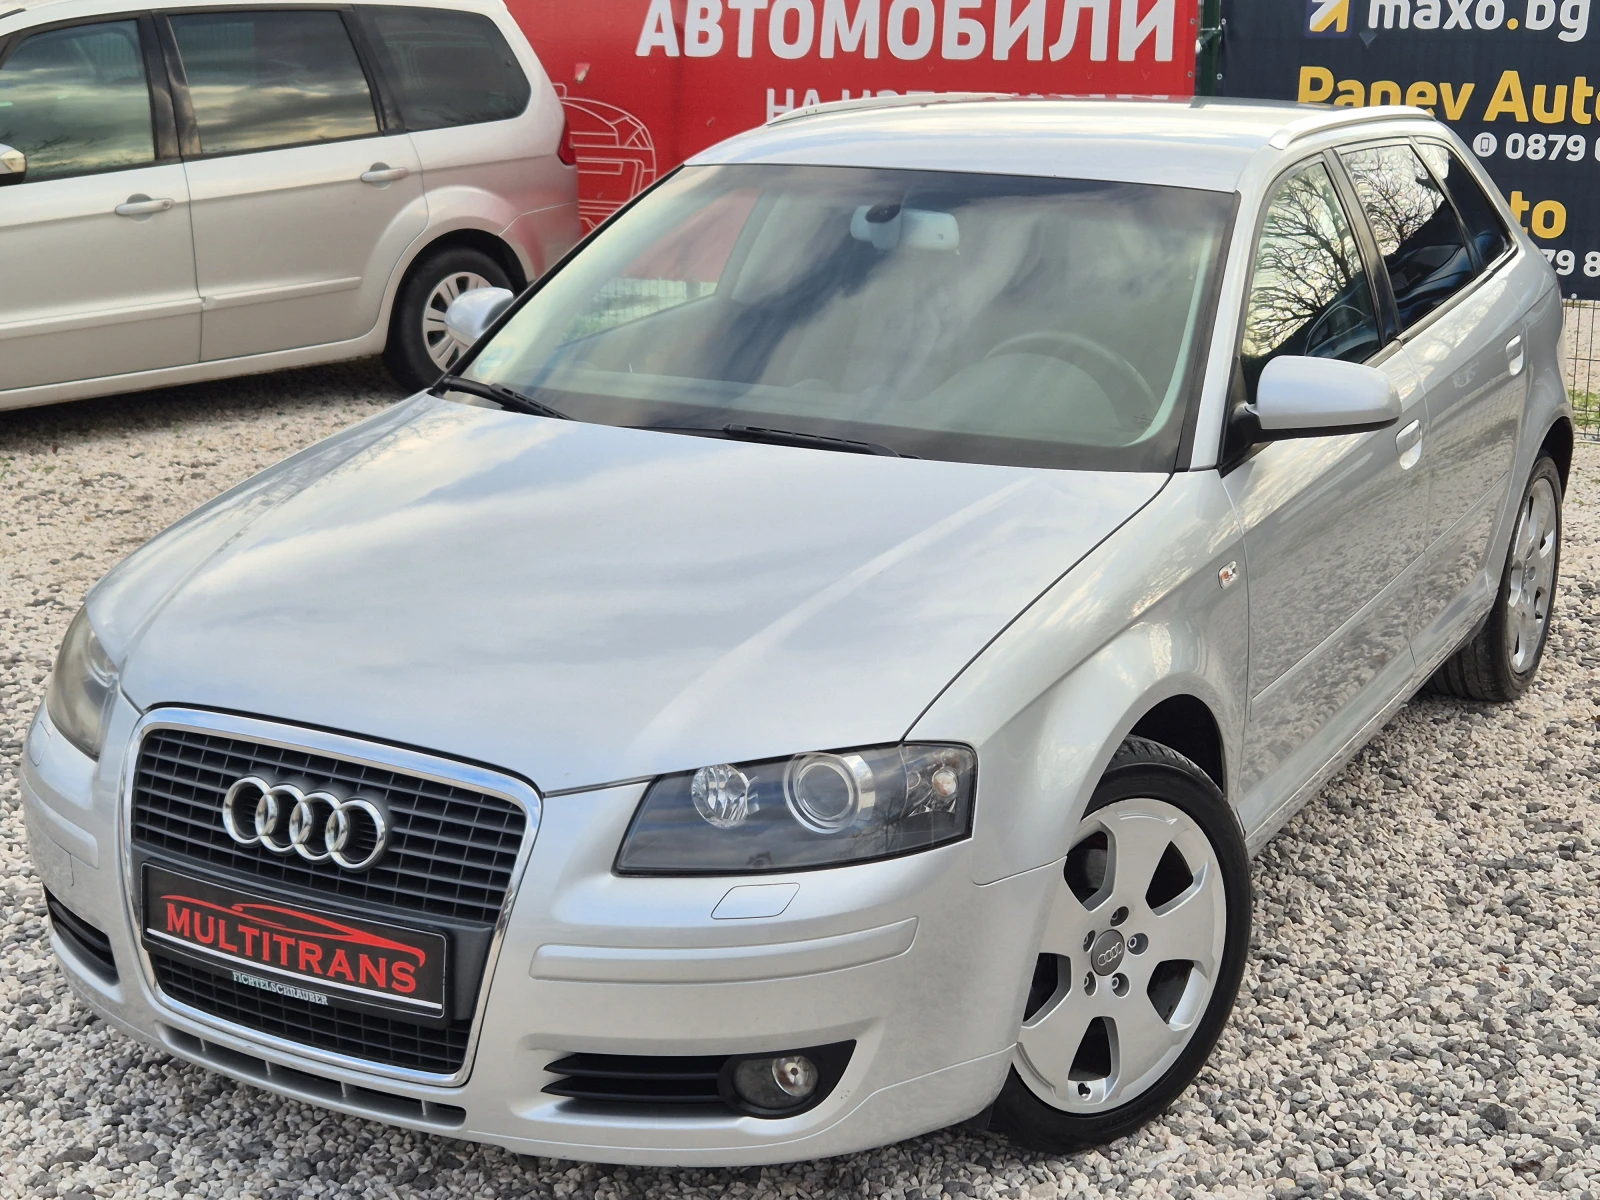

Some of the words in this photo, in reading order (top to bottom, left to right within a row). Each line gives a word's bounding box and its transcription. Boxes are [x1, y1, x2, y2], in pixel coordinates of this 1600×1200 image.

[635, 0, 1174, 62] АВТОМОБИЛИ
[1367, 0, 1592, 43] maxo.bg
[1482, 69, 1600, 125] Aut
[1505, 132, 1586, 162] 0879
[1509, 190, 1567, 239] to
[165, 903, 417, 993] MULTITRANS
[232, 971, 329, 1006] FICHTELSCHRAUBER
